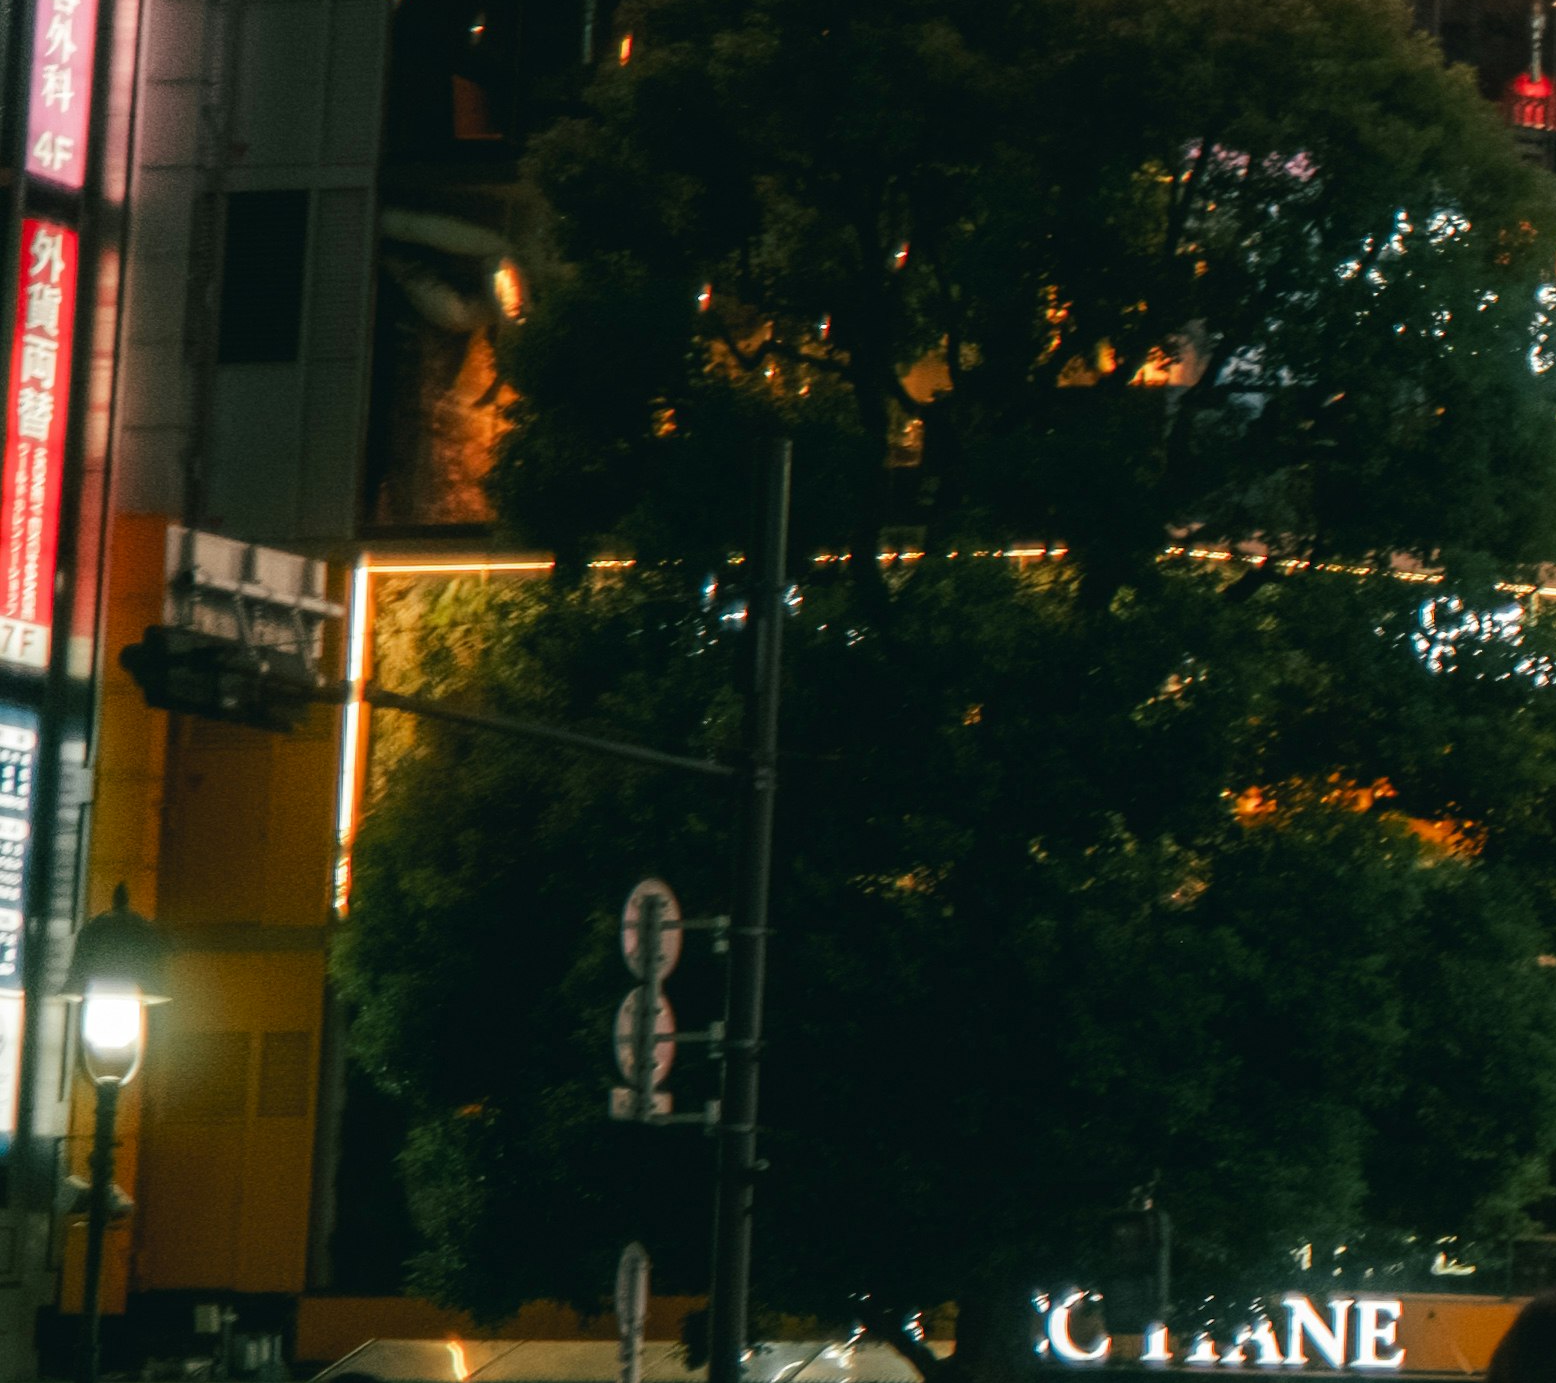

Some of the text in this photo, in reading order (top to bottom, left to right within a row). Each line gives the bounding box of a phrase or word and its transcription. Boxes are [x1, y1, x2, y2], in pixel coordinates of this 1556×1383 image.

[33, 129, 74, 170] 4F
[18, 229, 64, 442] 外貨両替
